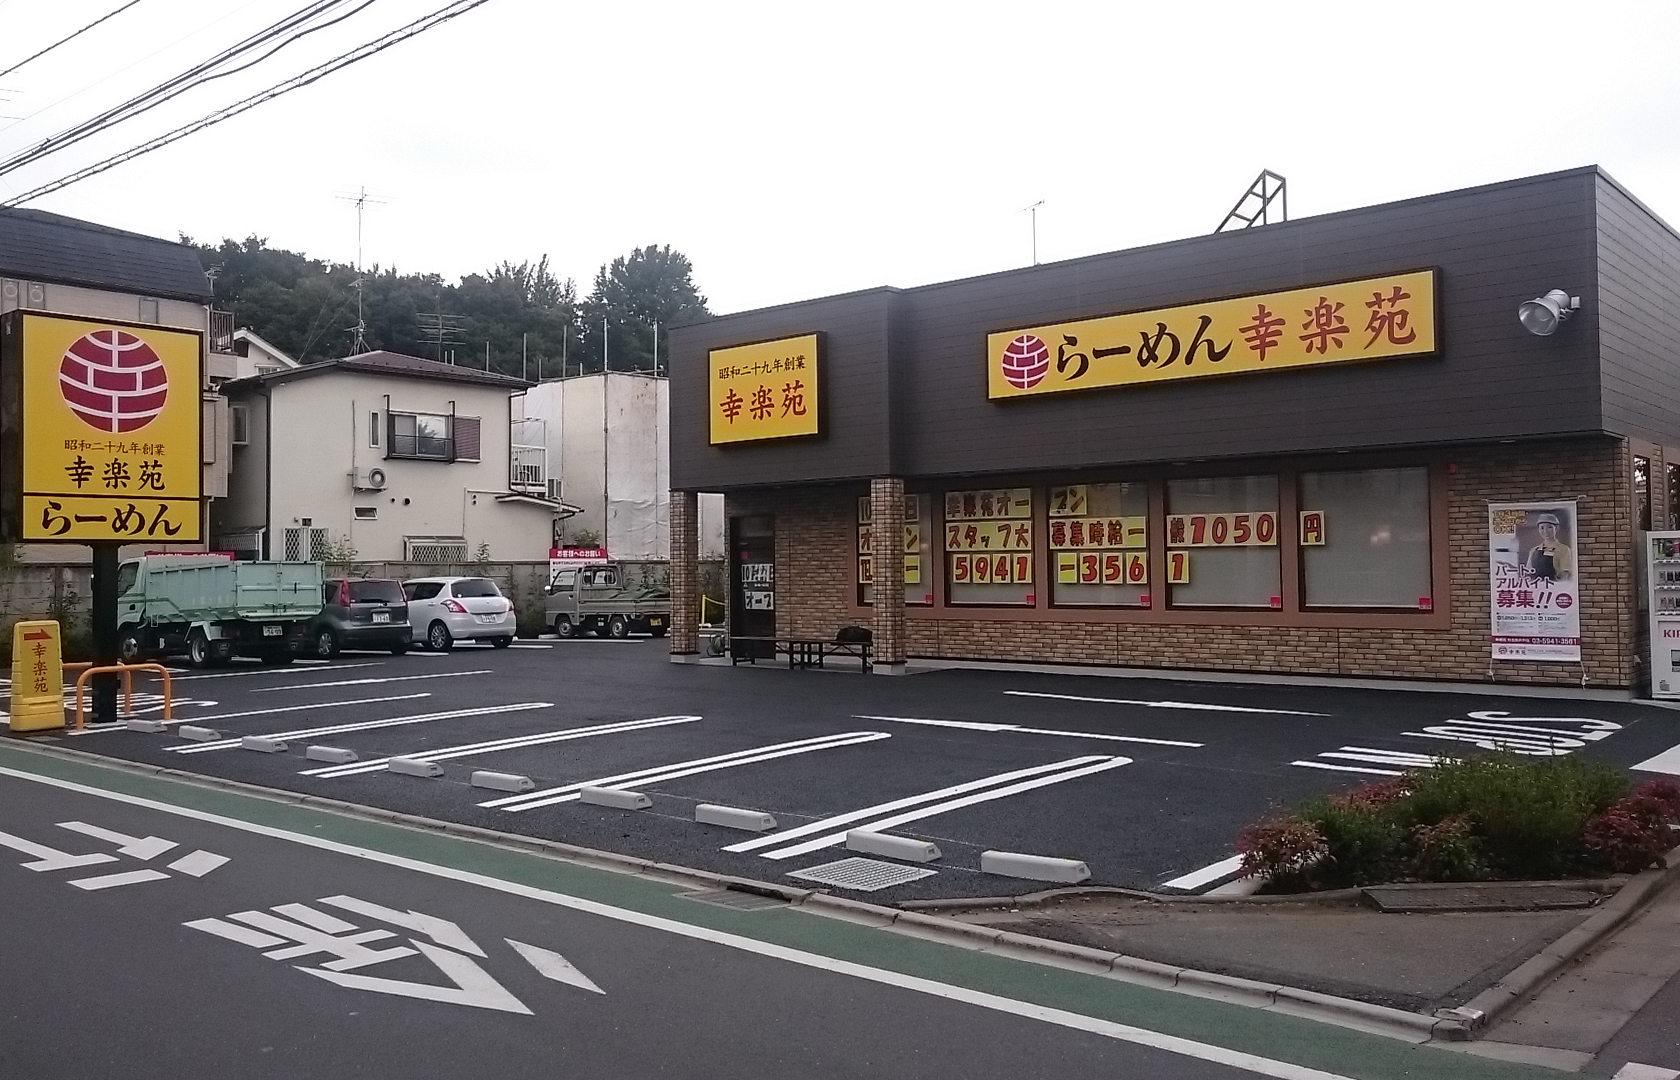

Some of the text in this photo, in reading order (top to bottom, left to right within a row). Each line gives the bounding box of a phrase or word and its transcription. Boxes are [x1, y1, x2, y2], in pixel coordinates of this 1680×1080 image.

[719, 355, 806, 379] 昭和二十九年創業
[720, 380, 807, 424] 幸楽苑
[64, 439, 165, 456] 昭和二十九年創業
[64, 455, 165, 490] 幸楽苑
[40, 500, 183, 536] らーめん
[1303, 513, 1322, 543] 円
[949, 523, 1029, 549] スタッフ大
[955, 556, 1028, 581] 5941
[1172, 553, 1184, 581] 1
[1496, 577, 1555, 589] アルバイト
[32, 642, 49, 693] 幸楽苑
